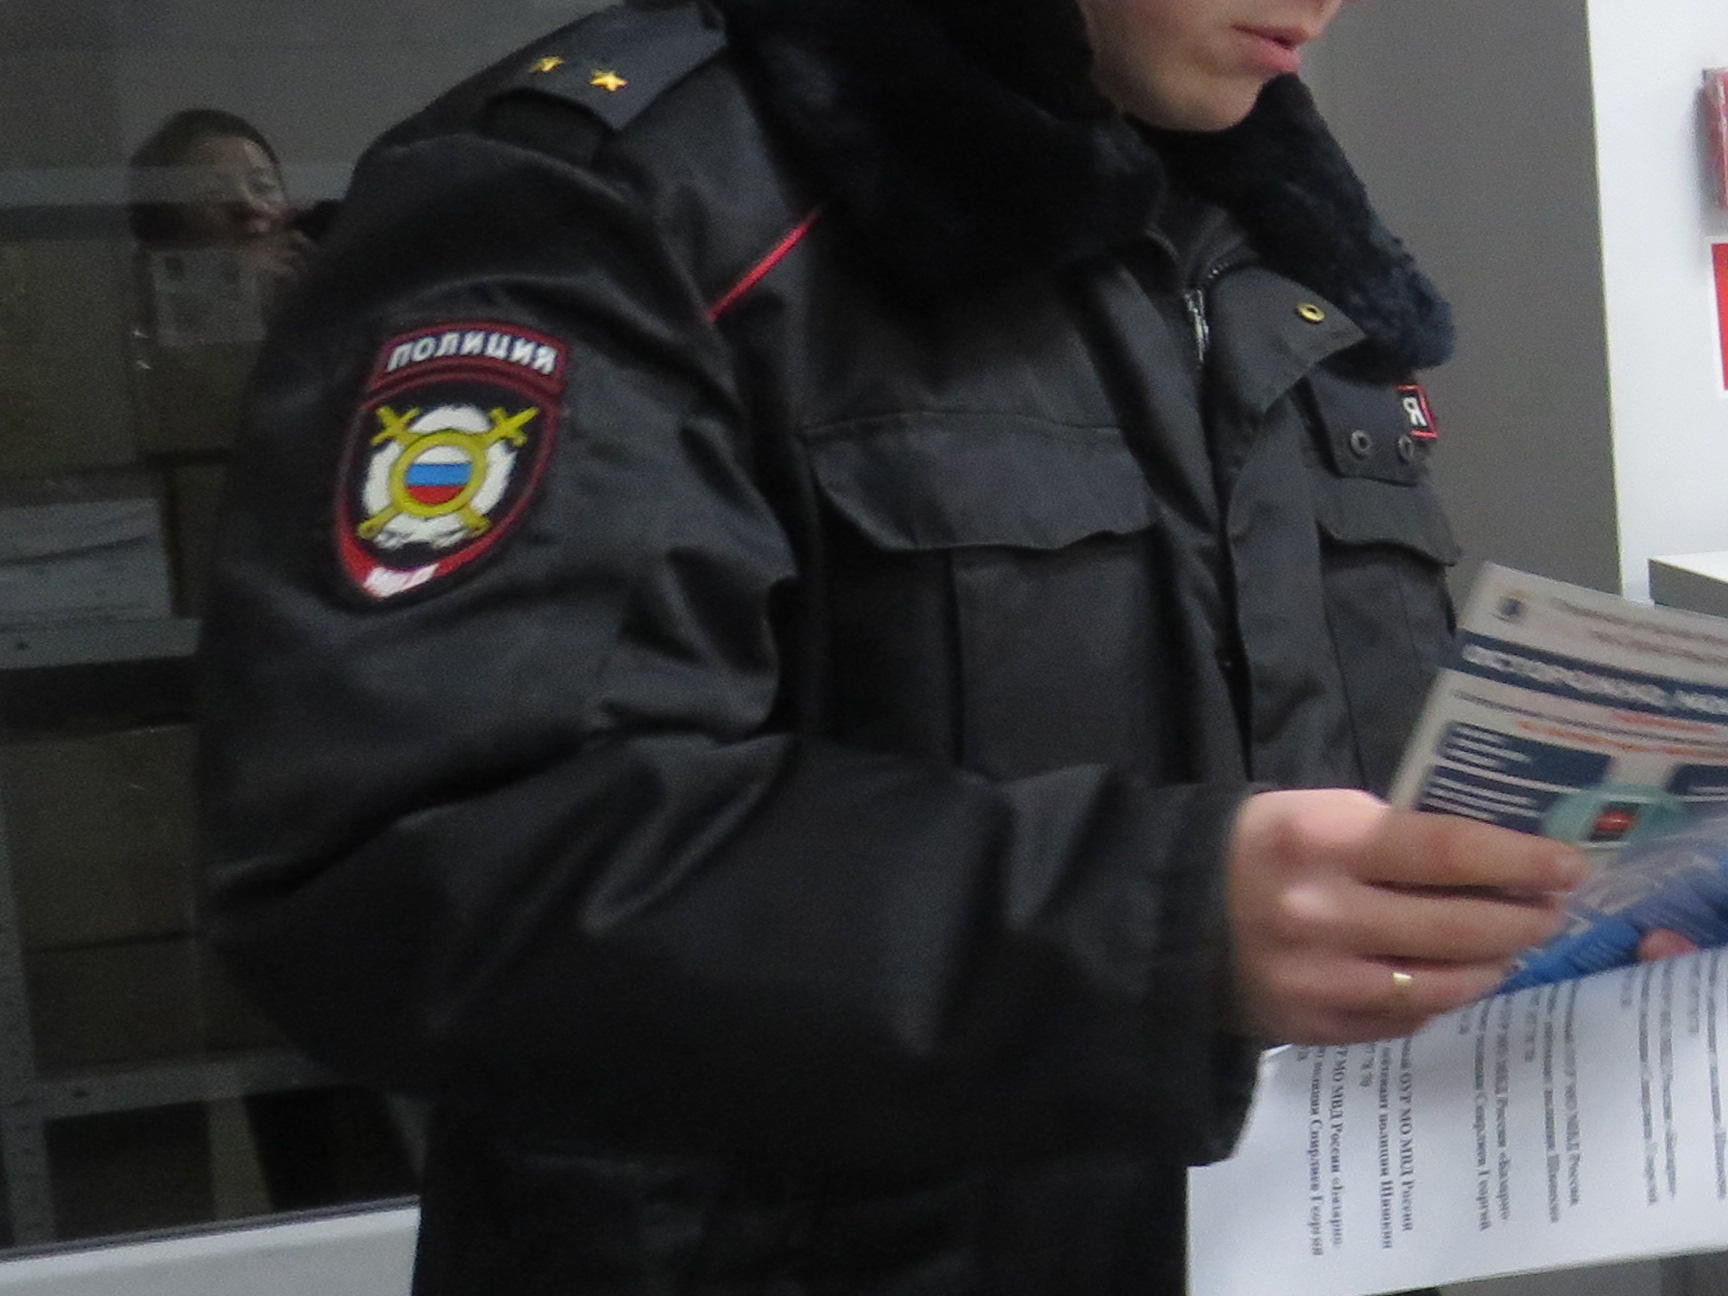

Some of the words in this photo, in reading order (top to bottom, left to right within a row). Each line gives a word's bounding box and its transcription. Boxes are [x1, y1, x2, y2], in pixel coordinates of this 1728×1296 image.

[386, 329, 558, 375] ПОЛИЦИЯ
[1329, 1084, 1345, 1121] МВД
[1330, 1121, 1346, 1173] России
[1401, 1179, 1417, 1232] России
